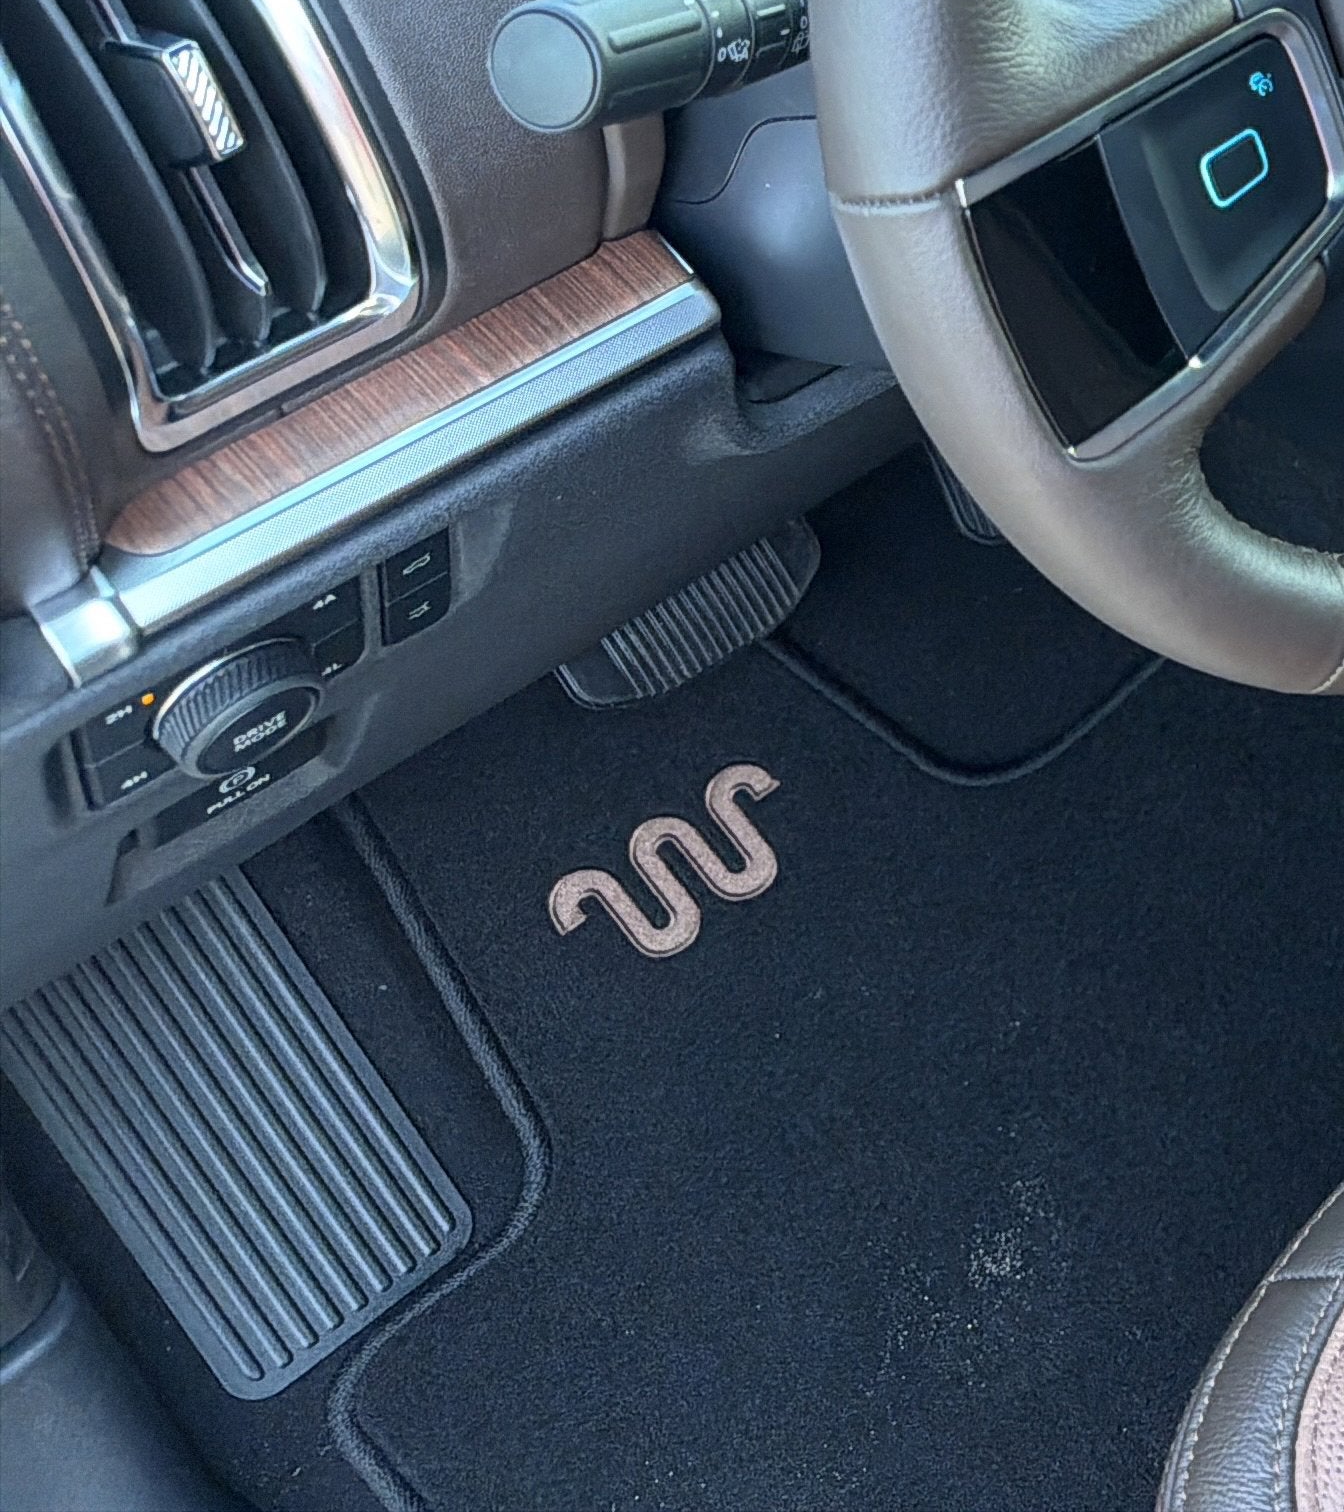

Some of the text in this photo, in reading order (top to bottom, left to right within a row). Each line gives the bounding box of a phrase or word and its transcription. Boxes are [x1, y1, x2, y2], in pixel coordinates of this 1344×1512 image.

[312, 593, 338, 610] 4A
[105, 704, 133, 725] 2H
[232, 709, 287, 747] DRIVE
[234, 718, 288, 753] MODE
[121, 770, 148, 790] 4H
[207, 773, 271, 815] PULL ON
